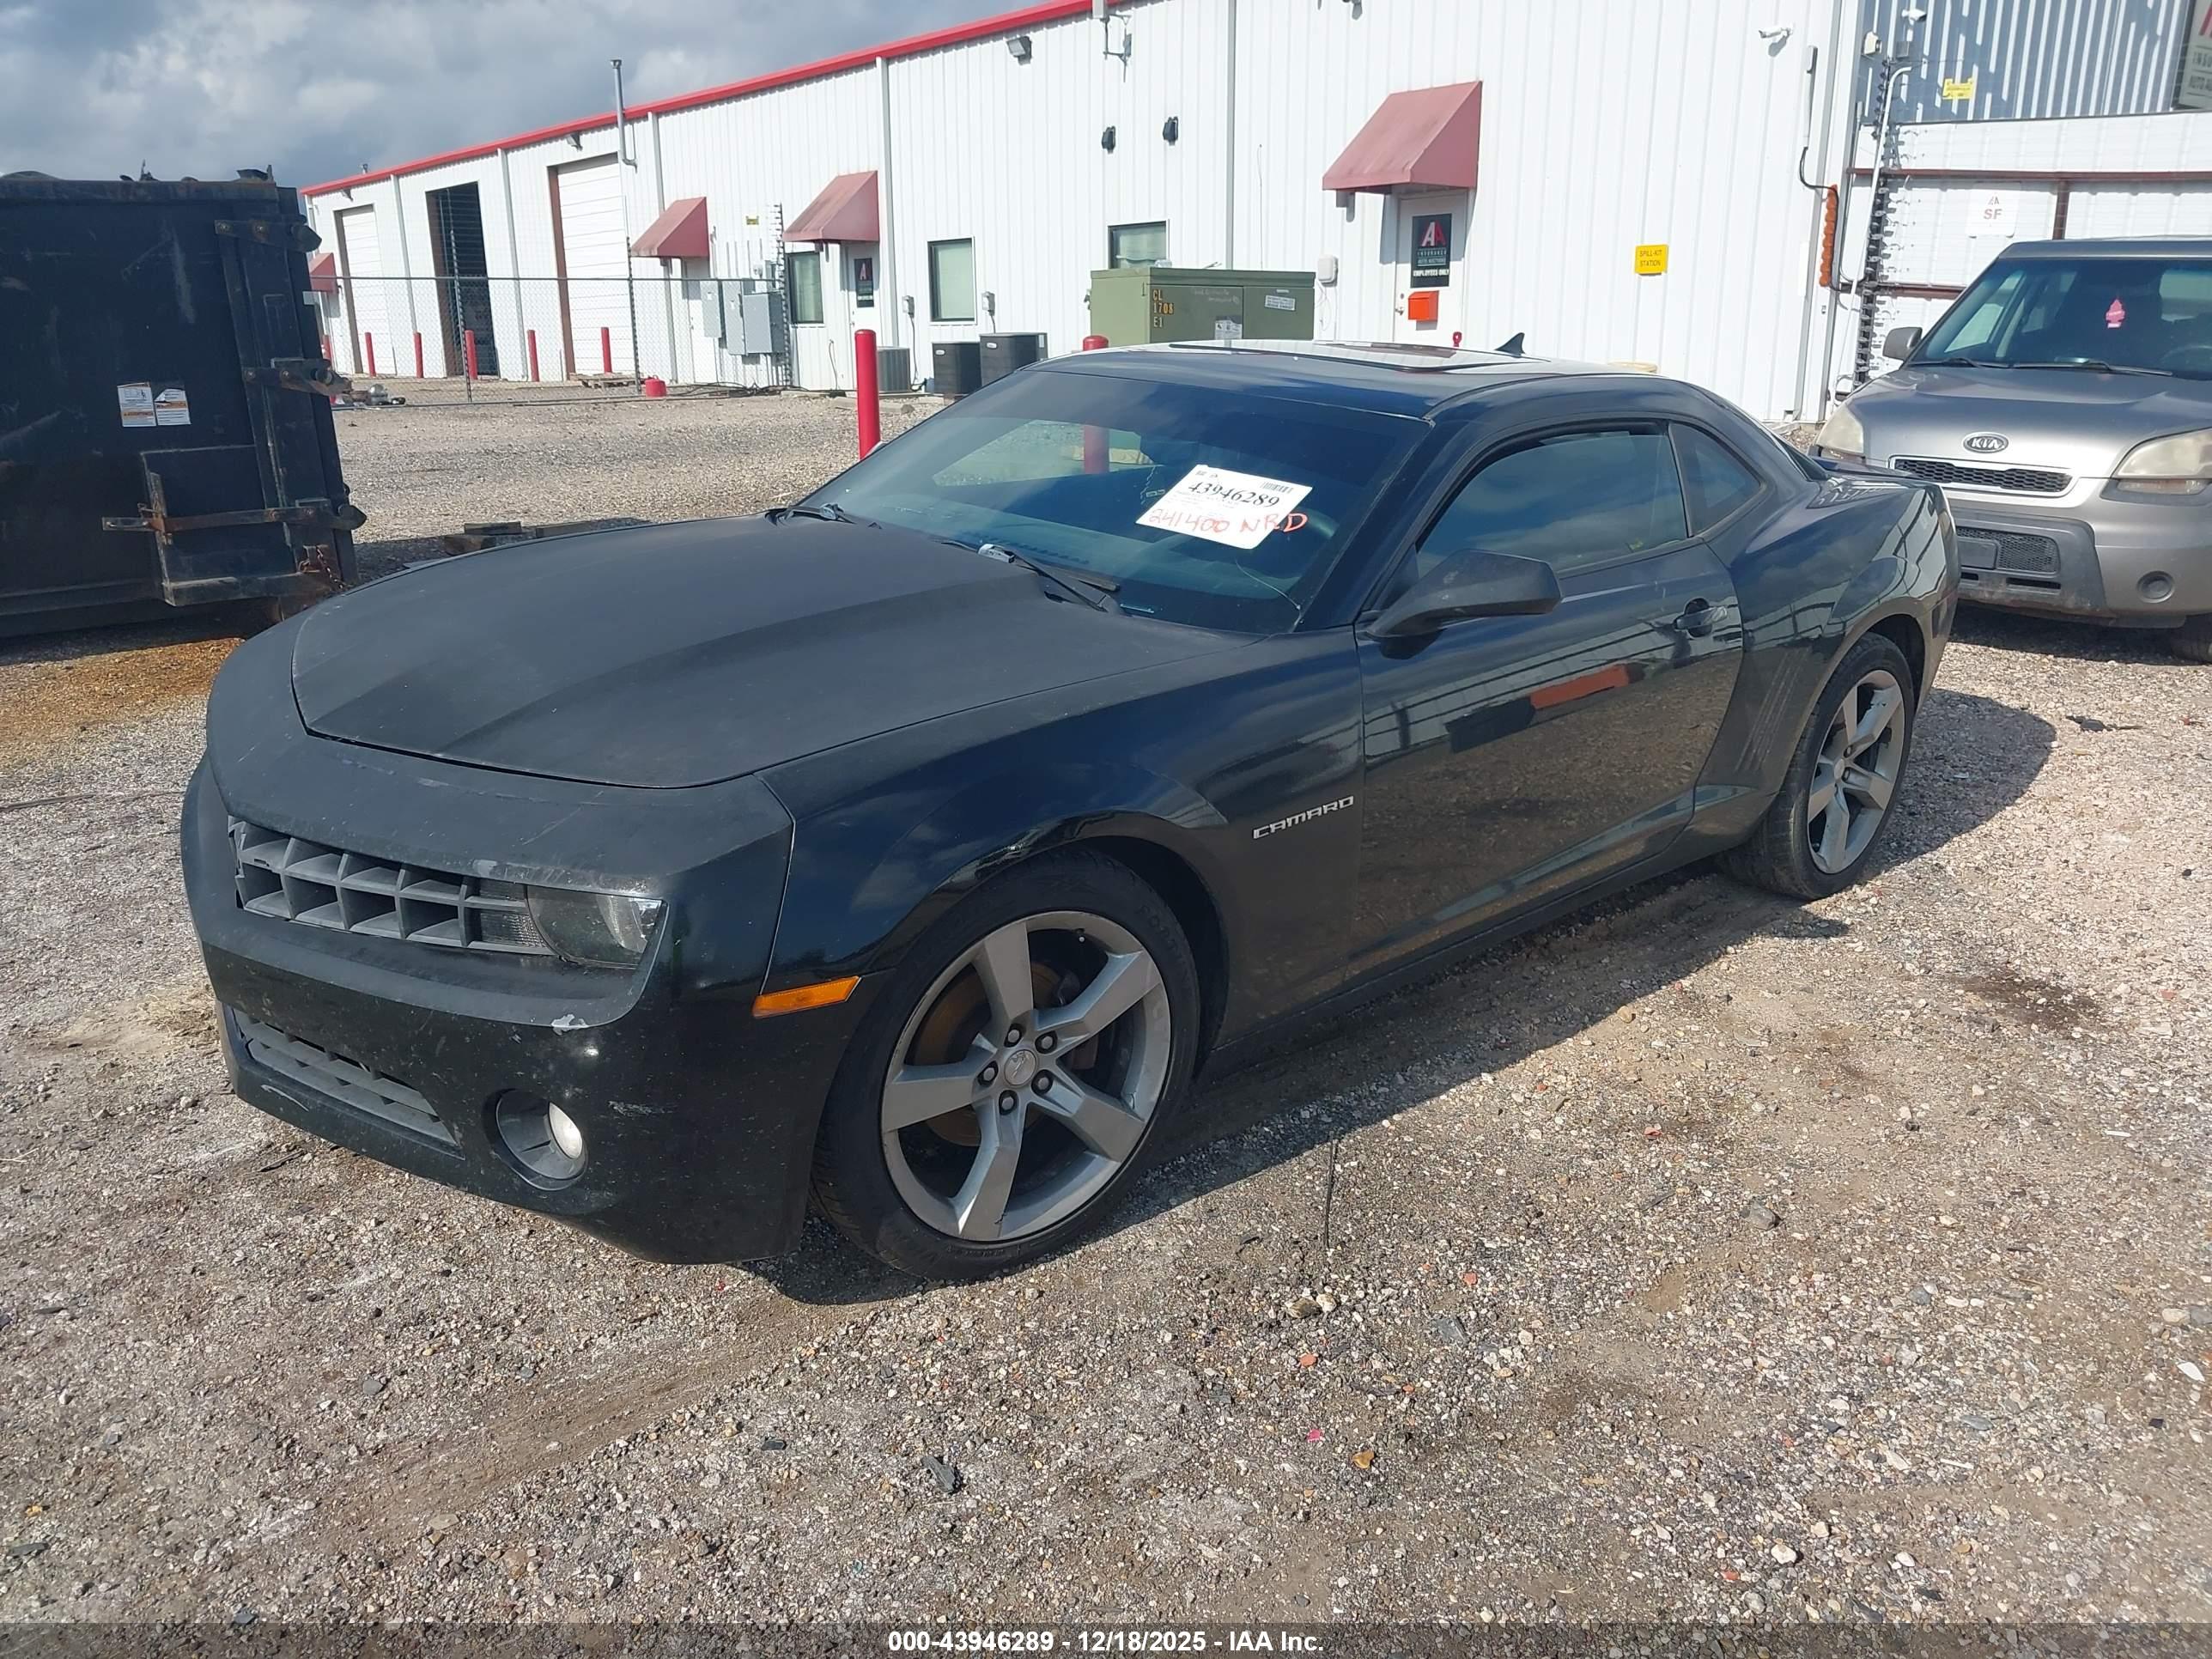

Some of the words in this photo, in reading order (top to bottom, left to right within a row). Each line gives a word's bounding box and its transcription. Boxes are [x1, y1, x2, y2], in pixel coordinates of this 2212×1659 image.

[1984, 208, 2003, 220] SF
[1152, 289, 1163, 301] CL
[1153, 302, 1174, 314] 1708
[1153, 316, 1163, 327] E1
[1971, 437, 2000, 449] KIA
[1188, 481, 1280, 508] 43946289
[1253, 795, 1354, 839] CAMARO
